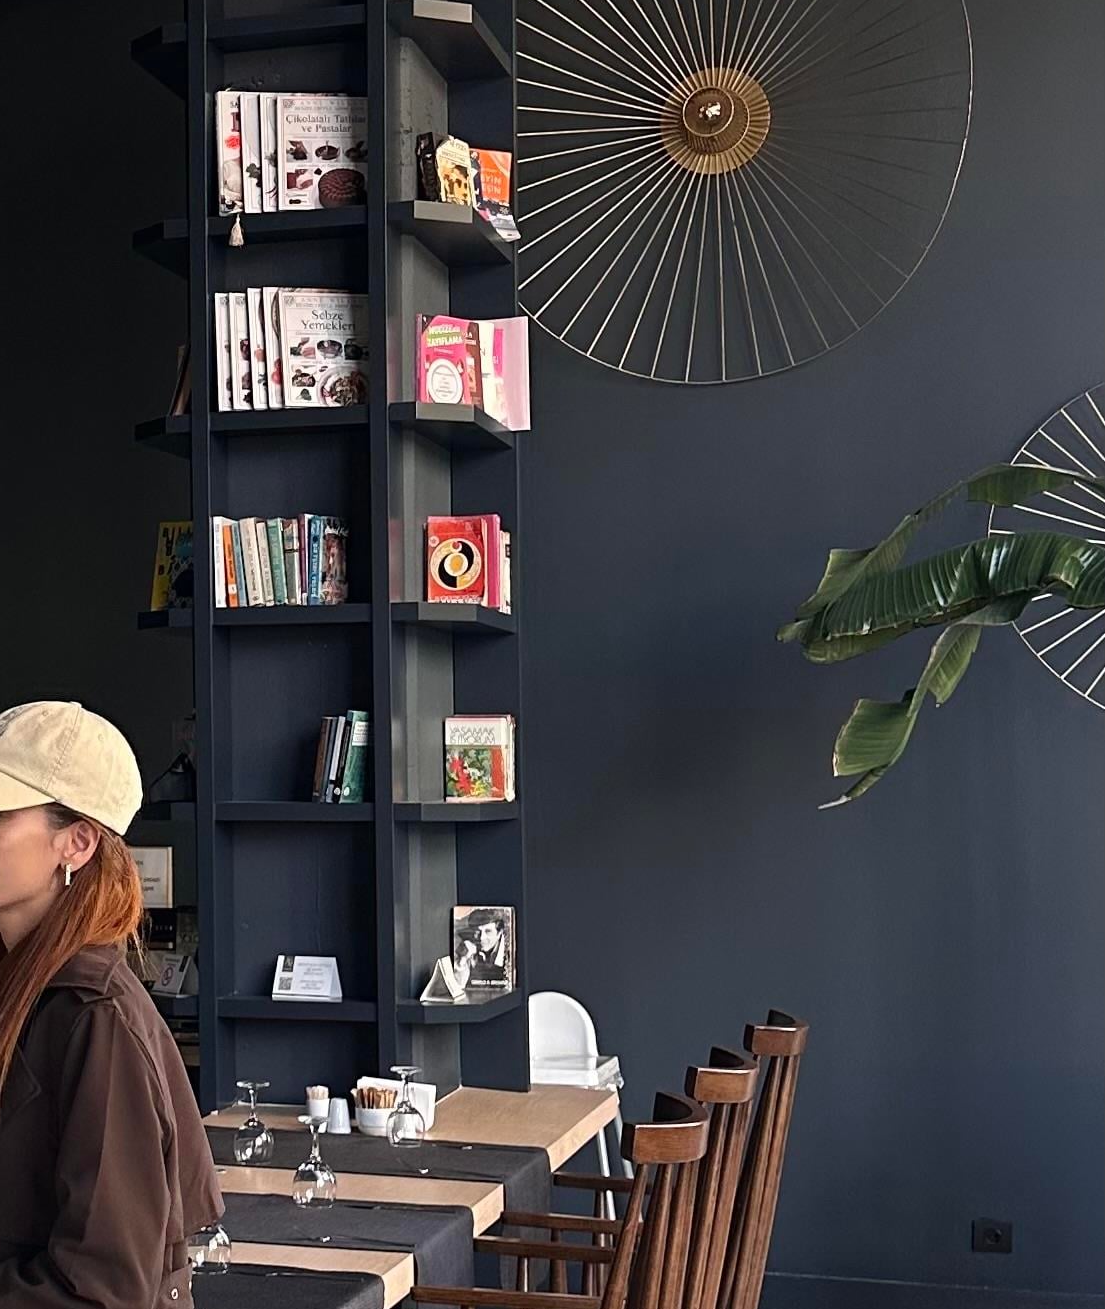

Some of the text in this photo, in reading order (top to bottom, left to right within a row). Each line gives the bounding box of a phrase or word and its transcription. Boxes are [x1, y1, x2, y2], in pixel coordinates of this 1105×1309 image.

[285, 114, 330, 124] Çikolatalı
[316, 124, 352, 132] Pastalar
[312, 310, 344, 320] Sebze
[301, 319, 356, 330] Yemekleri
